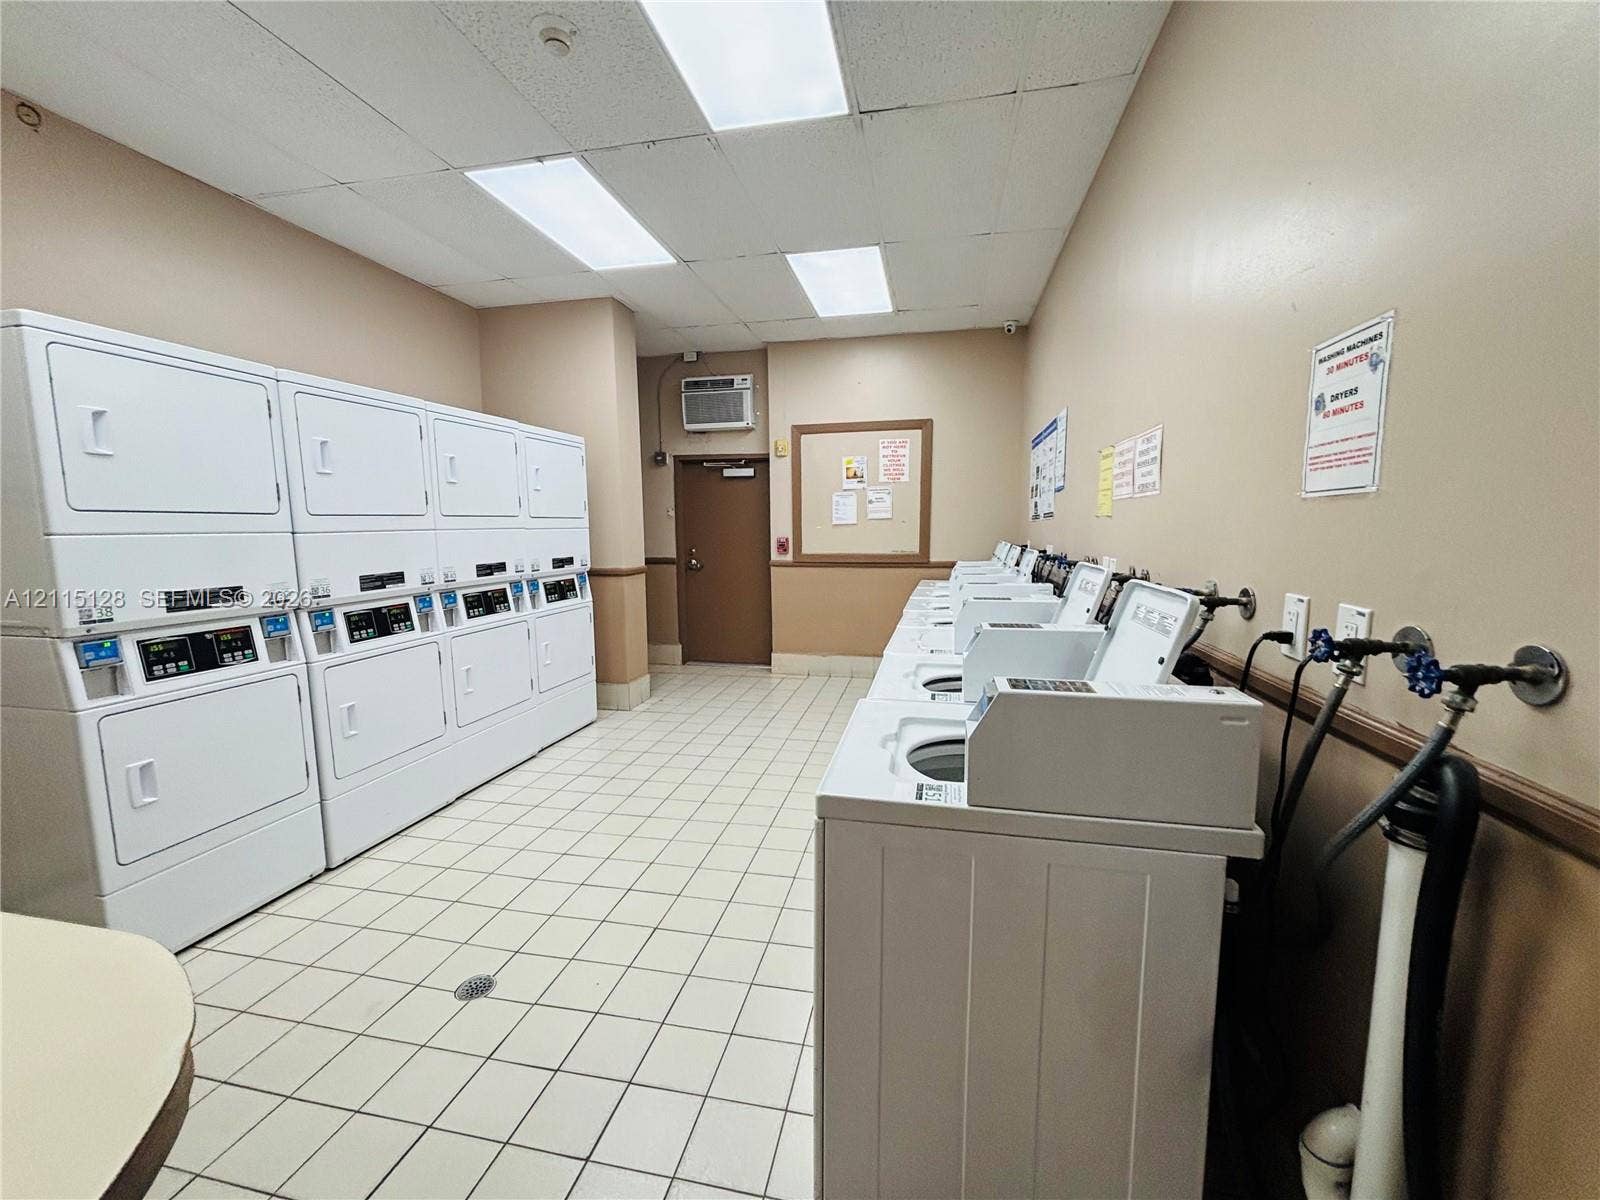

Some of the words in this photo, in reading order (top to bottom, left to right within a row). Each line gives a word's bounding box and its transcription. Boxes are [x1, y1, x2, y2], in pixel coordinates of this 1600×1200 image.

[1318, 347, 1345, 365] WASHING
[1346, 331, 1384, 353] MACHINES
[1326, 366, 1335, 376] 30
[1335, 352, 1370, 371] MINUTES
[1330, 386, 1359, 403] DRYERS
[1322, 410, 1331, 419] 60
[1332, 400, 1364, 417] MINUTES
[320, 586, 331, 595] 36
[97, 607, 114, 617] 38
